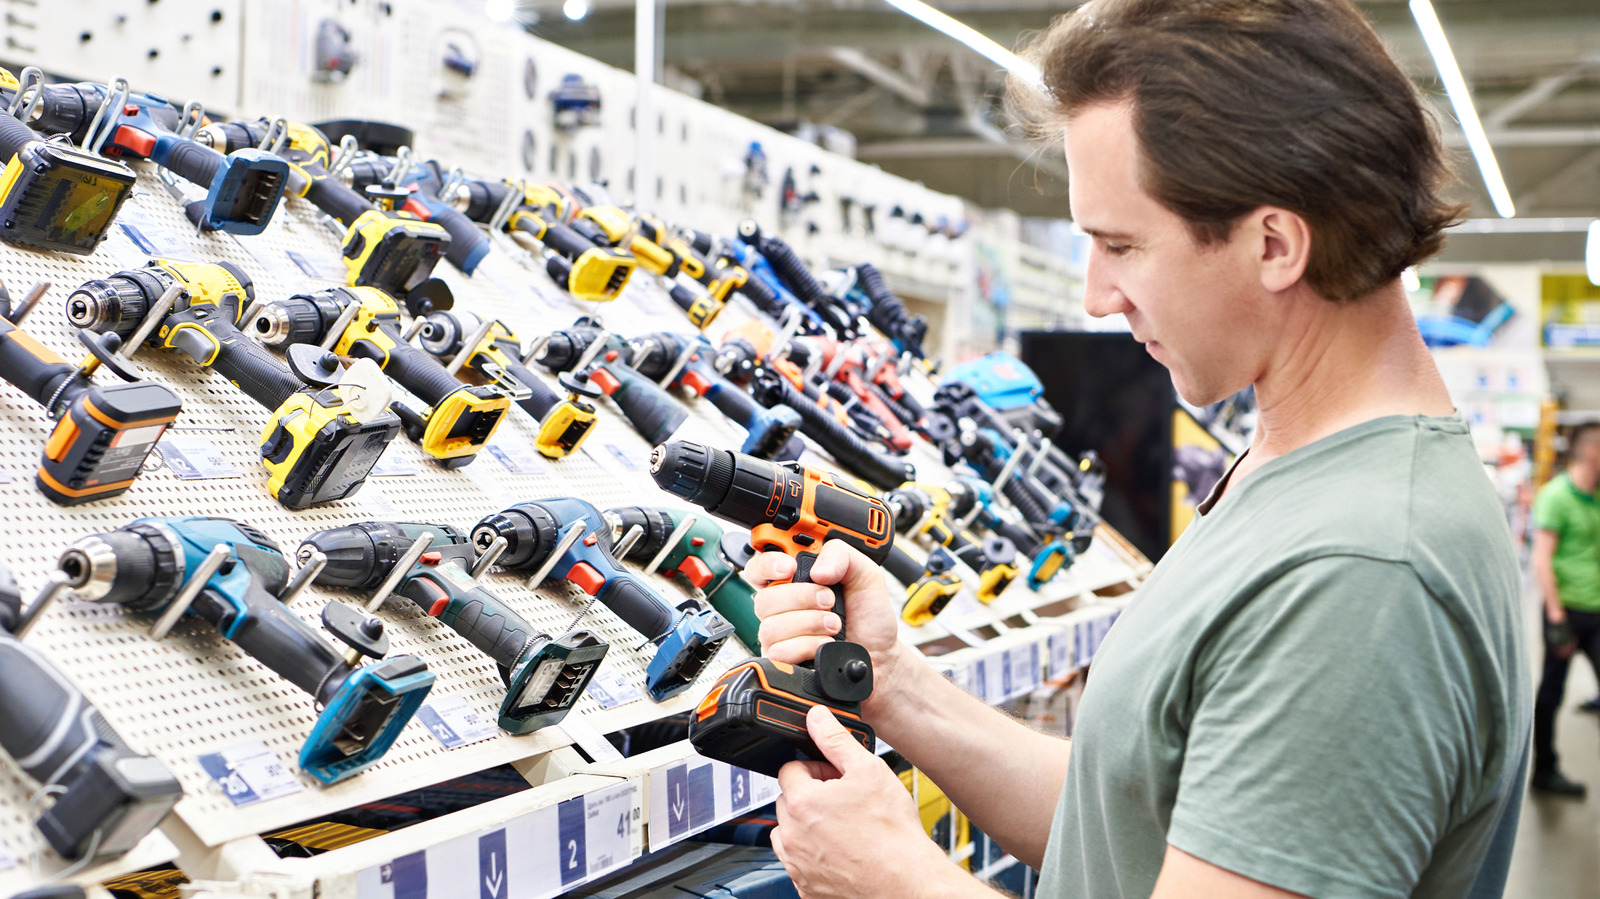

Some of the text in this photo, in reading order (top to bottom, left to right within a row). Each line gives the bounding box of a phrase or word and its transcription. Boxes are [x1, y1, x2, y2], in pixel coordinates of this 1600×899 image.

[168, 457, 192, 471] 12
[432, 723, 454, 739] 21
[736, 774, 744, 799] 3
[617, 810, 631, 838] 41
[632, 807, 641, 821] 00
[568, 839, 578, 869] 2
